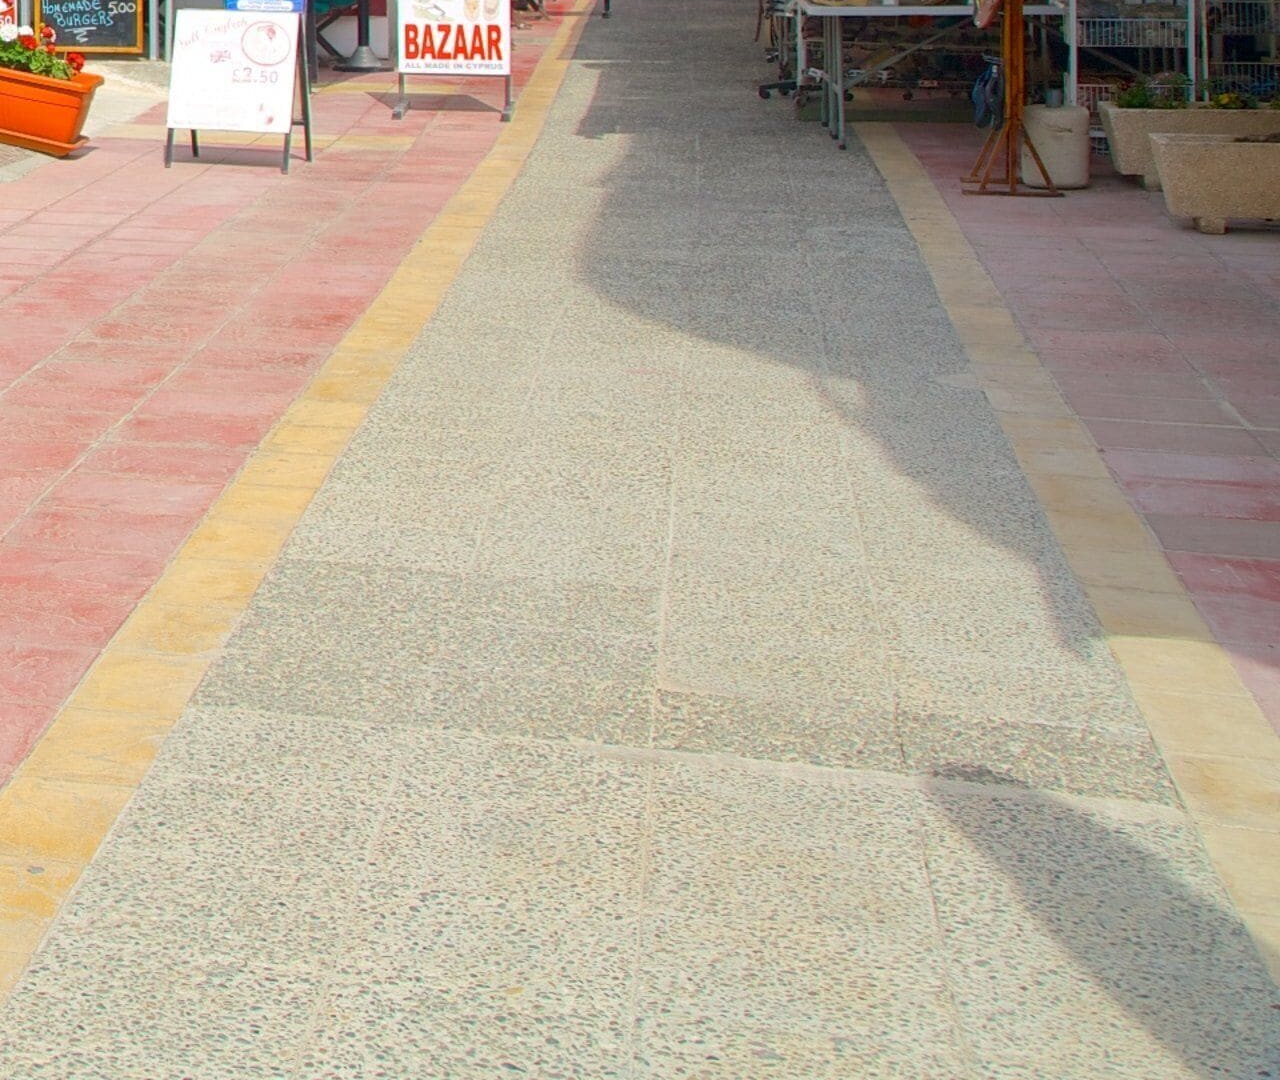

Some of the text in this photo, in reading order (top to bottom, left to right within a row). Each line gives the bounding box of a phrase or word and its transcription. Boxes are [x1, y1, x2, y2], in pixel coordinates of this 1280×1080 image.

[54, 10, 114, 27] BURGERS
[405, 24, 502, 60] BAZAAR
[425, 62, 450, 70] MADE
[466, 63, 503, 71] CYPRUS
